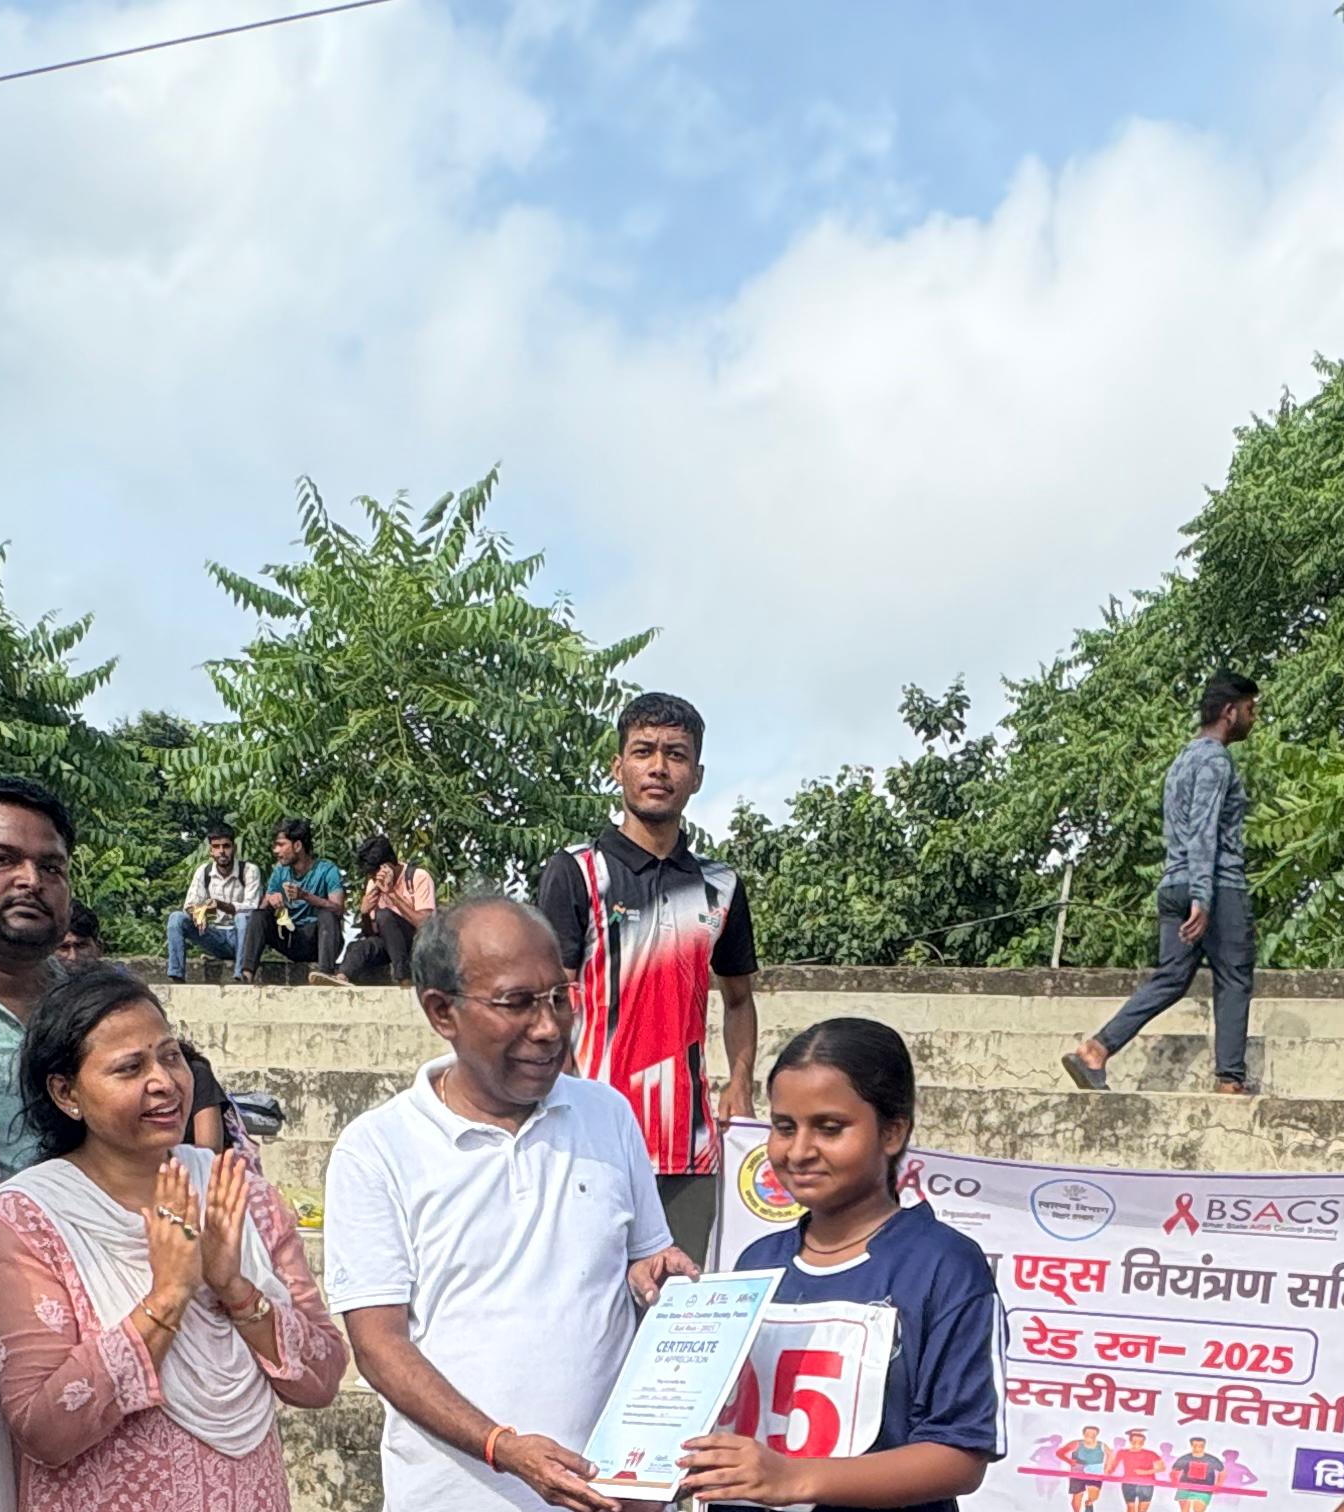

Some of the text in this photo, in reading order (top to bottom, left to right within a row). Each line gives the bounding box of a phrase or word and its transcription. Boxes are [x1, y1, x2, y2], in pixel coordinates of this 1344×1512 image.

[896, 1159, 981, 1200] ACO
[1206, 1199, 1341, 1225] BSACS
[1013, 1254, 1111, 1306] एड्स
[1121, 1247, 1277, 1304] नियंत्रण
[656, 1340, 719, 1353] CERTIFICATE
[1022, 1316, 1083, 1360] रेड
[1201, 1340, 1294, 1375] 2025
